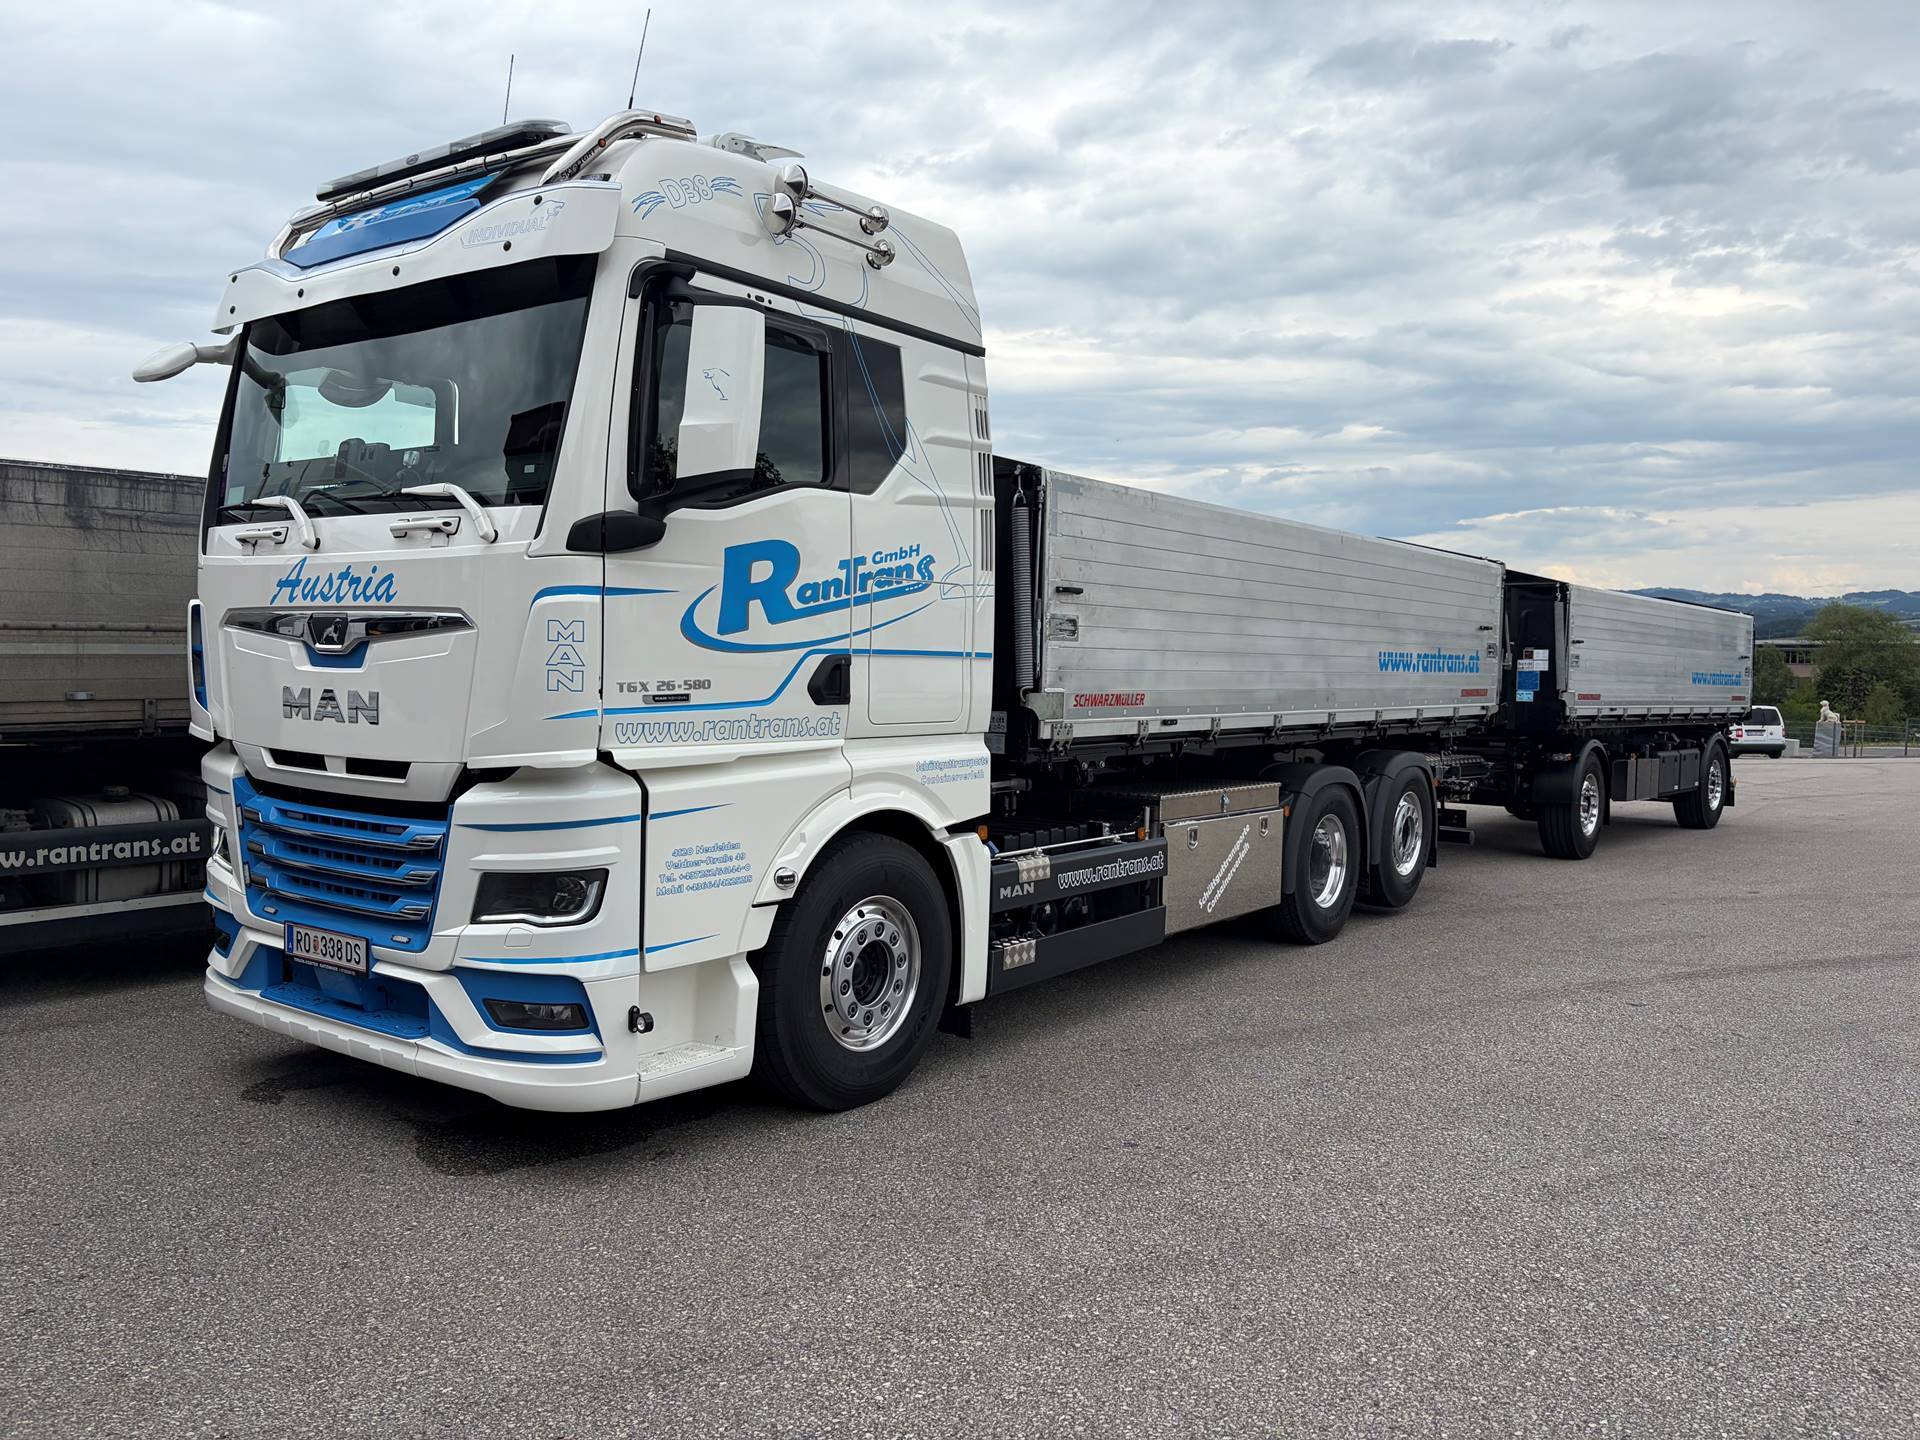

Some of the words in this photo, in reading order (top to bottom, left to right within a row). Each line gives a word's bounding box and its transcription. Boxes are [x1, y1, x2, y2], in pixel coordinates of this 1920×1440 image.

[658, 174, 714, 210] D38
[466, 217, 546, 244] INDIVIDUAL
[871, 543, 921, 566] GmbH
[269, 556, 399, 606] Austria
[716, 539, 936, 636] RanTrans
[546, 619, 586, 693] MAN
[1378, 648, 1481, 674] www.rantrans.at
[616, 681, 650, 694] TGX
[1072, 692, 1146, 708] SCHWARZMÜLLER
[282, 685, 380, 726] MAN
[615, 713, 842, 745] www.rantrans.at
[696, 842, 741, 854] Neufelden
[656, 884, 684, 896] Mobil
[1000, 882, 1035, 900] MAN
[1057, 851, 1164, 890] www.rantrans.at
[296, 930, 311, 954] RO
[320, 936, 343, 961] 338
[345, 941, 361, 965] DS
